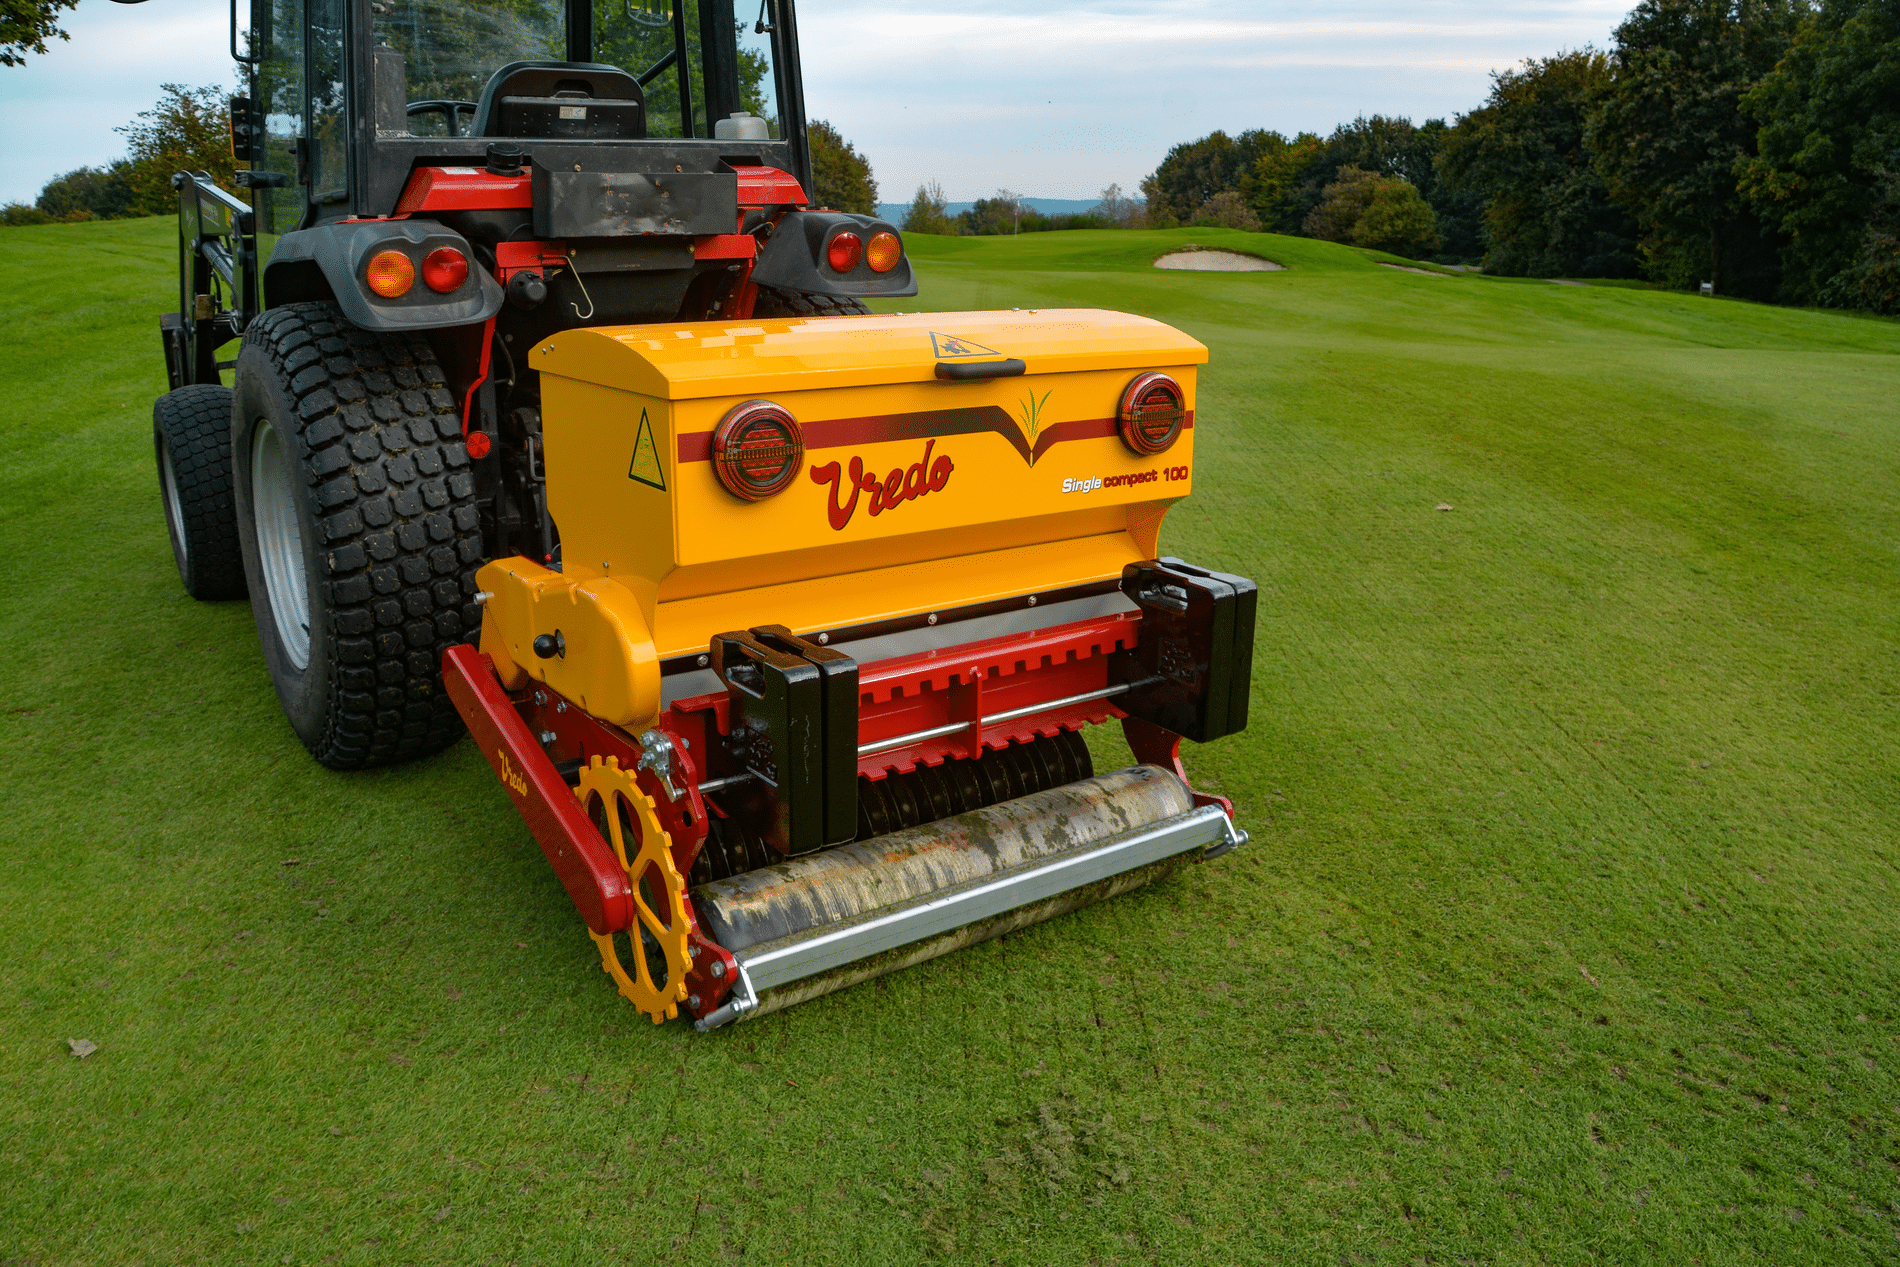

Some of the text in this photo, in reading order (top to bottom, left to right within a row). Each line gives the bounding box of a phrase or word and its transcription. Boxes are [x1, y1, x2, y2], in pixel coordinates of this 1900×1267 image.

[810, 439, 954, 531] Vredo
[1062, 466, 1188, 493] Single compact 100
[498, 748, 528, 797] Vredo
